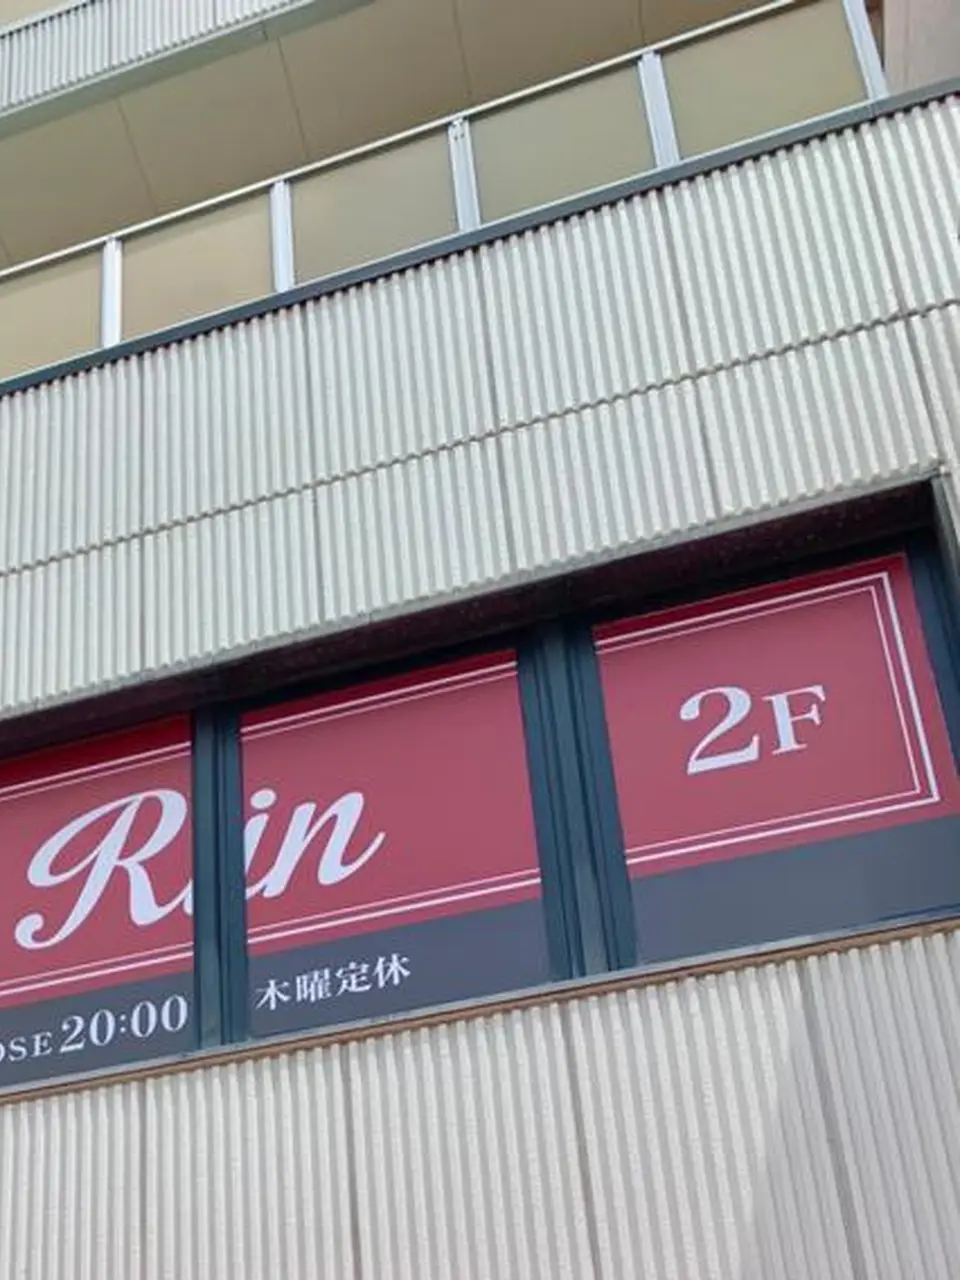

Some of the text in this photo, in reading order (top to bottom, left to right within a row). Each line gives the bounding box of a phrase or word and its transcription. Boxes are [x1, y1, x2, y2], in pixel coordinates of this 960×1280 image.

[679, 685, 826, 775] 2F
[15, 788, 387, 951] Rin
[255, 953, 411, 1011] 木曜定休
[59, 995, 189, 1053] 20:00
